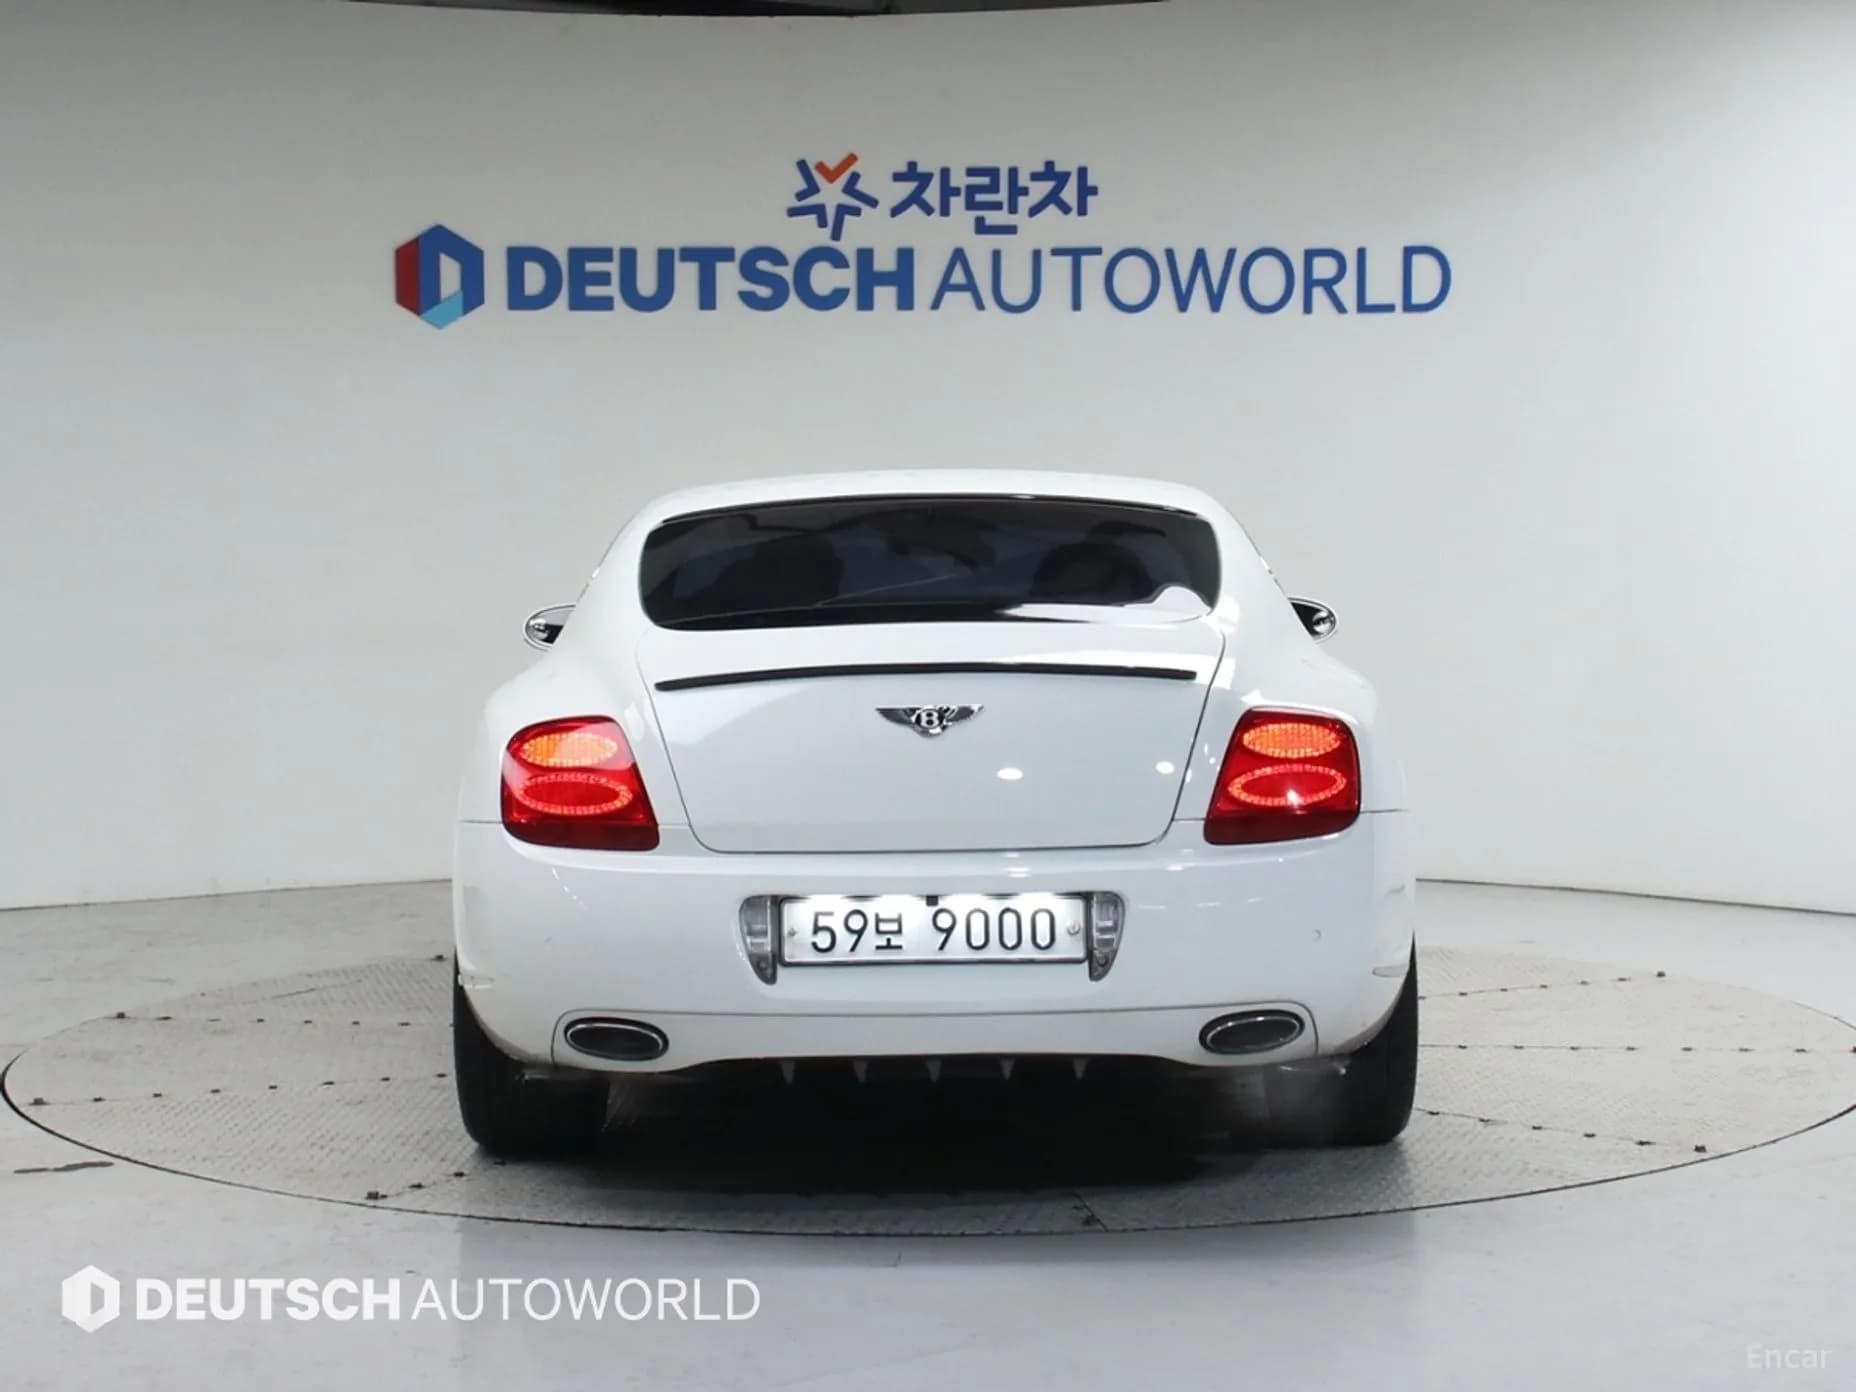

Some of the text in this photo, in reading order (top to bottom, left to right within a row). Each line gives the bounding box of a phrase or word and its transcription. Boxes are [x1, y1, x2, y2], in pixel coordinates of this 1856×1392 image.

[890, 160, 1098, 235] 차란차
[506, 245, 1452, 314] DEUTSCH AUTOWORLD
[811, 907, 1056, 953] 59보 9000
